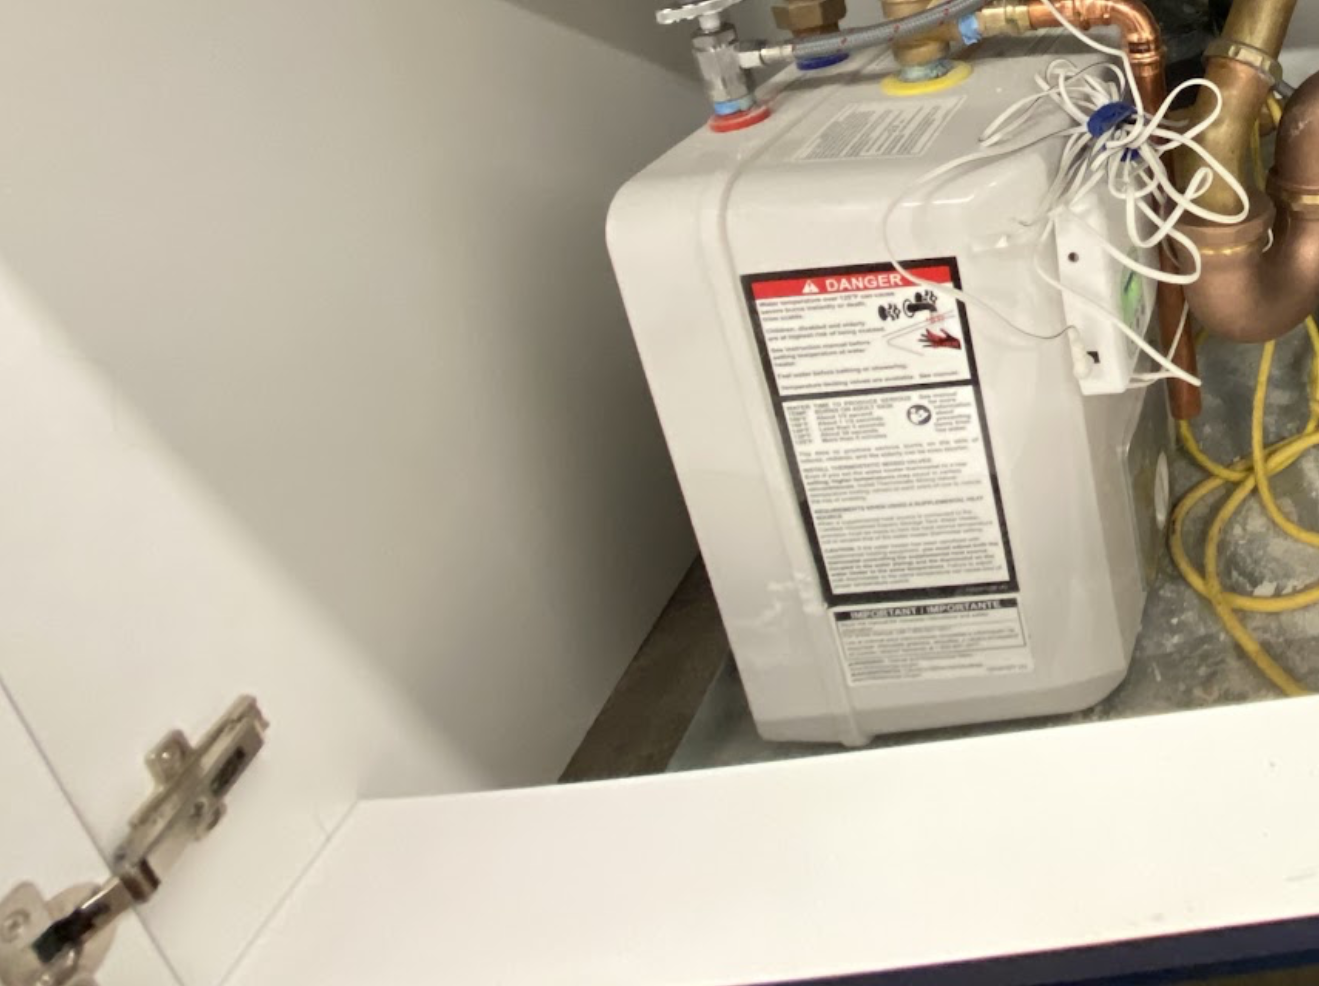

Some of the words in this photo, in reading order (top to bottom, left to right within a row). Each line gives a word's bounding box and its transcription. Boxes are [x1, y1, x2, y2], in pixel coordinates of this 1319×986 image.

[825, 274, 903, 292] DANGER
[850, 606, 917, 619] IMPORTANT
[925, 600, 1001, 614] IMPORTANTE
